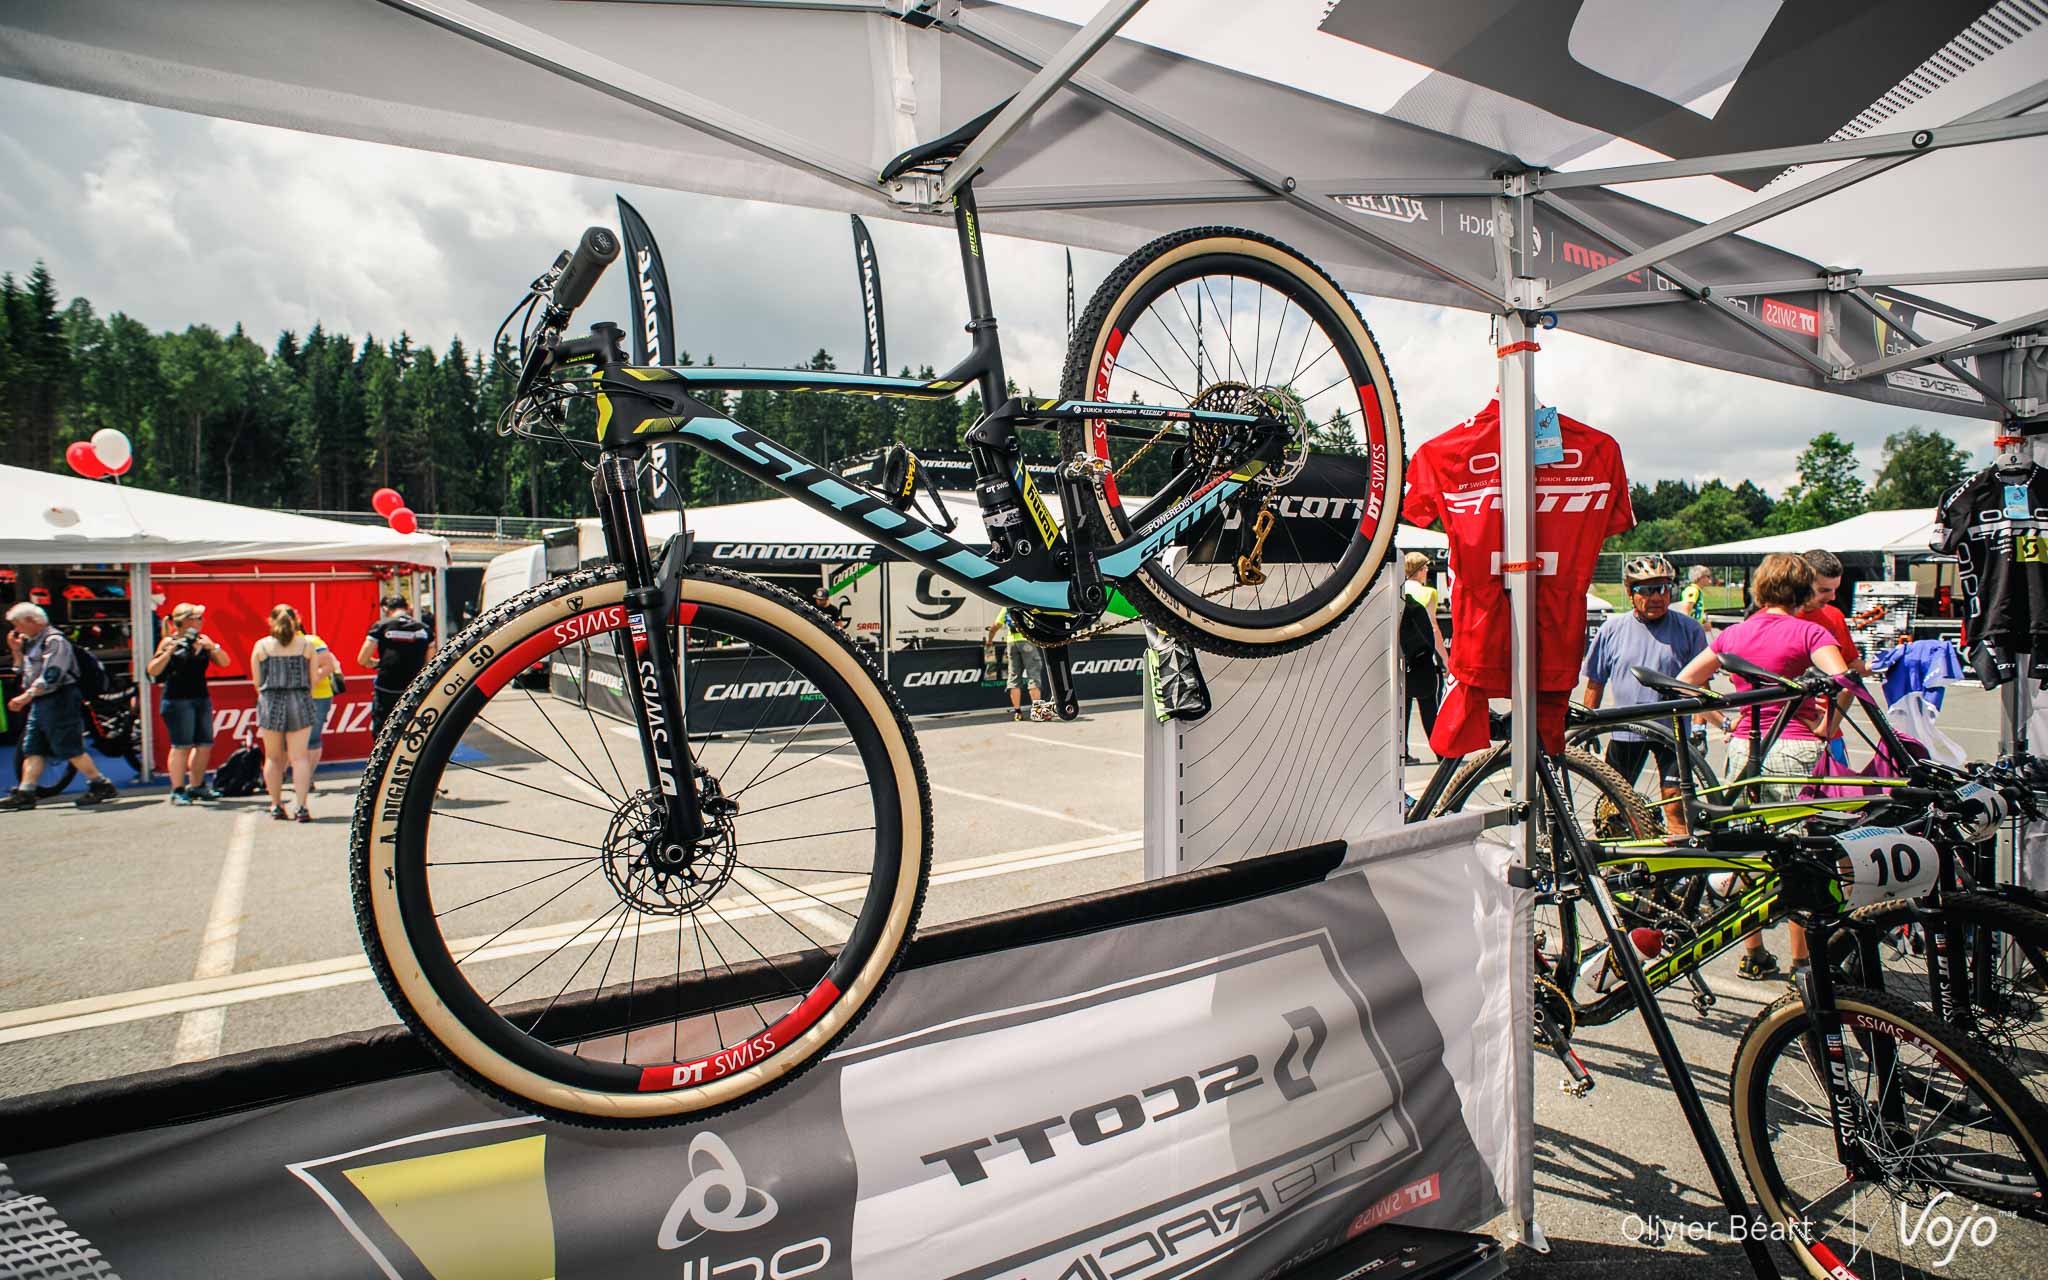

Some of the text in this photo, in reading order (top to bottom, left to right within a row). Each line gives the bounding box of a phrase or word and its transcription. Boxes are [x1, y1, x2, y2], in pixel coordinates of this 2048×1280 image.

[1101, 351, 1115, 384] DT
[1366, 443, 1385, 521] DT SWISS
[1469, 479, 1488, 489] SWISS
[712, 543, 876, 560] CANNONDALE
[554, 608, 621, 645] SWISS
[640, 661, 668, 743] SWISS
[382, 755, 415, 823] DUGAST
[443, 673, 466, 697] Ori
[468, 644, 495, 669] 50
[1870, 844, 1920, 887] 10
[1936, 955, 1951, 979] DT
[1857, 1014, 1905, 1040] SWISS
[672, 1032, 776, 1087] DT SWISS
[1830, 1060, 1858, 1148] DT SWISS
